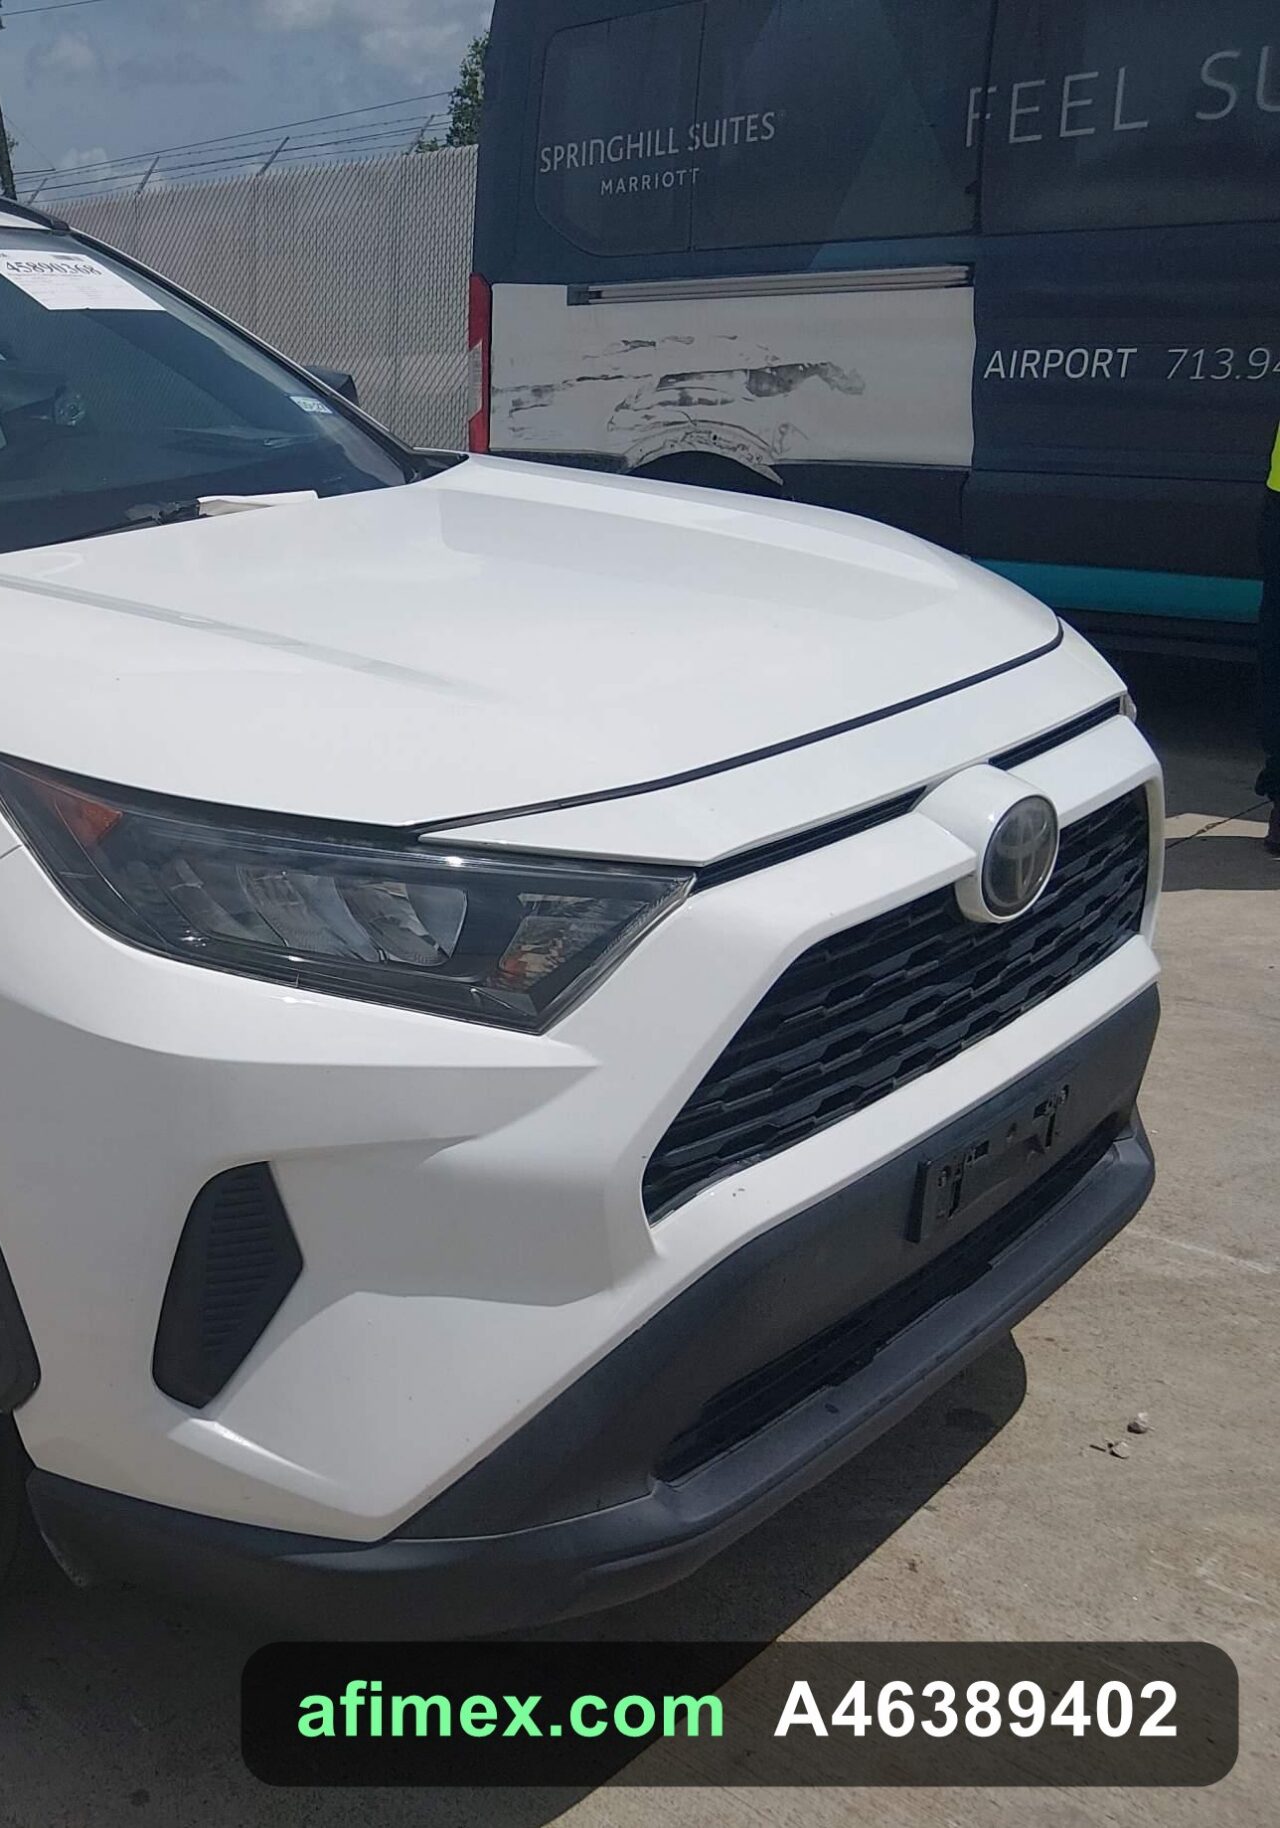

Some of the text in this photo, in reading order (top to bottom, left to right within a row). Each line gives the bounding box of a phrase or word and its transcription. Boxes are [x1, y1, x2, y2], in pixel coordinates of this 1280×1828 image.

[966, 66, 1149, 147] FEEL
[539, 111, 776, 173] SPRINGHILL SUITES
[600, 168, 700, 195] MARRIOTT
[6, 261, 103, 276] 45890368
[983, 348, 1138, 379] AIRPORT
